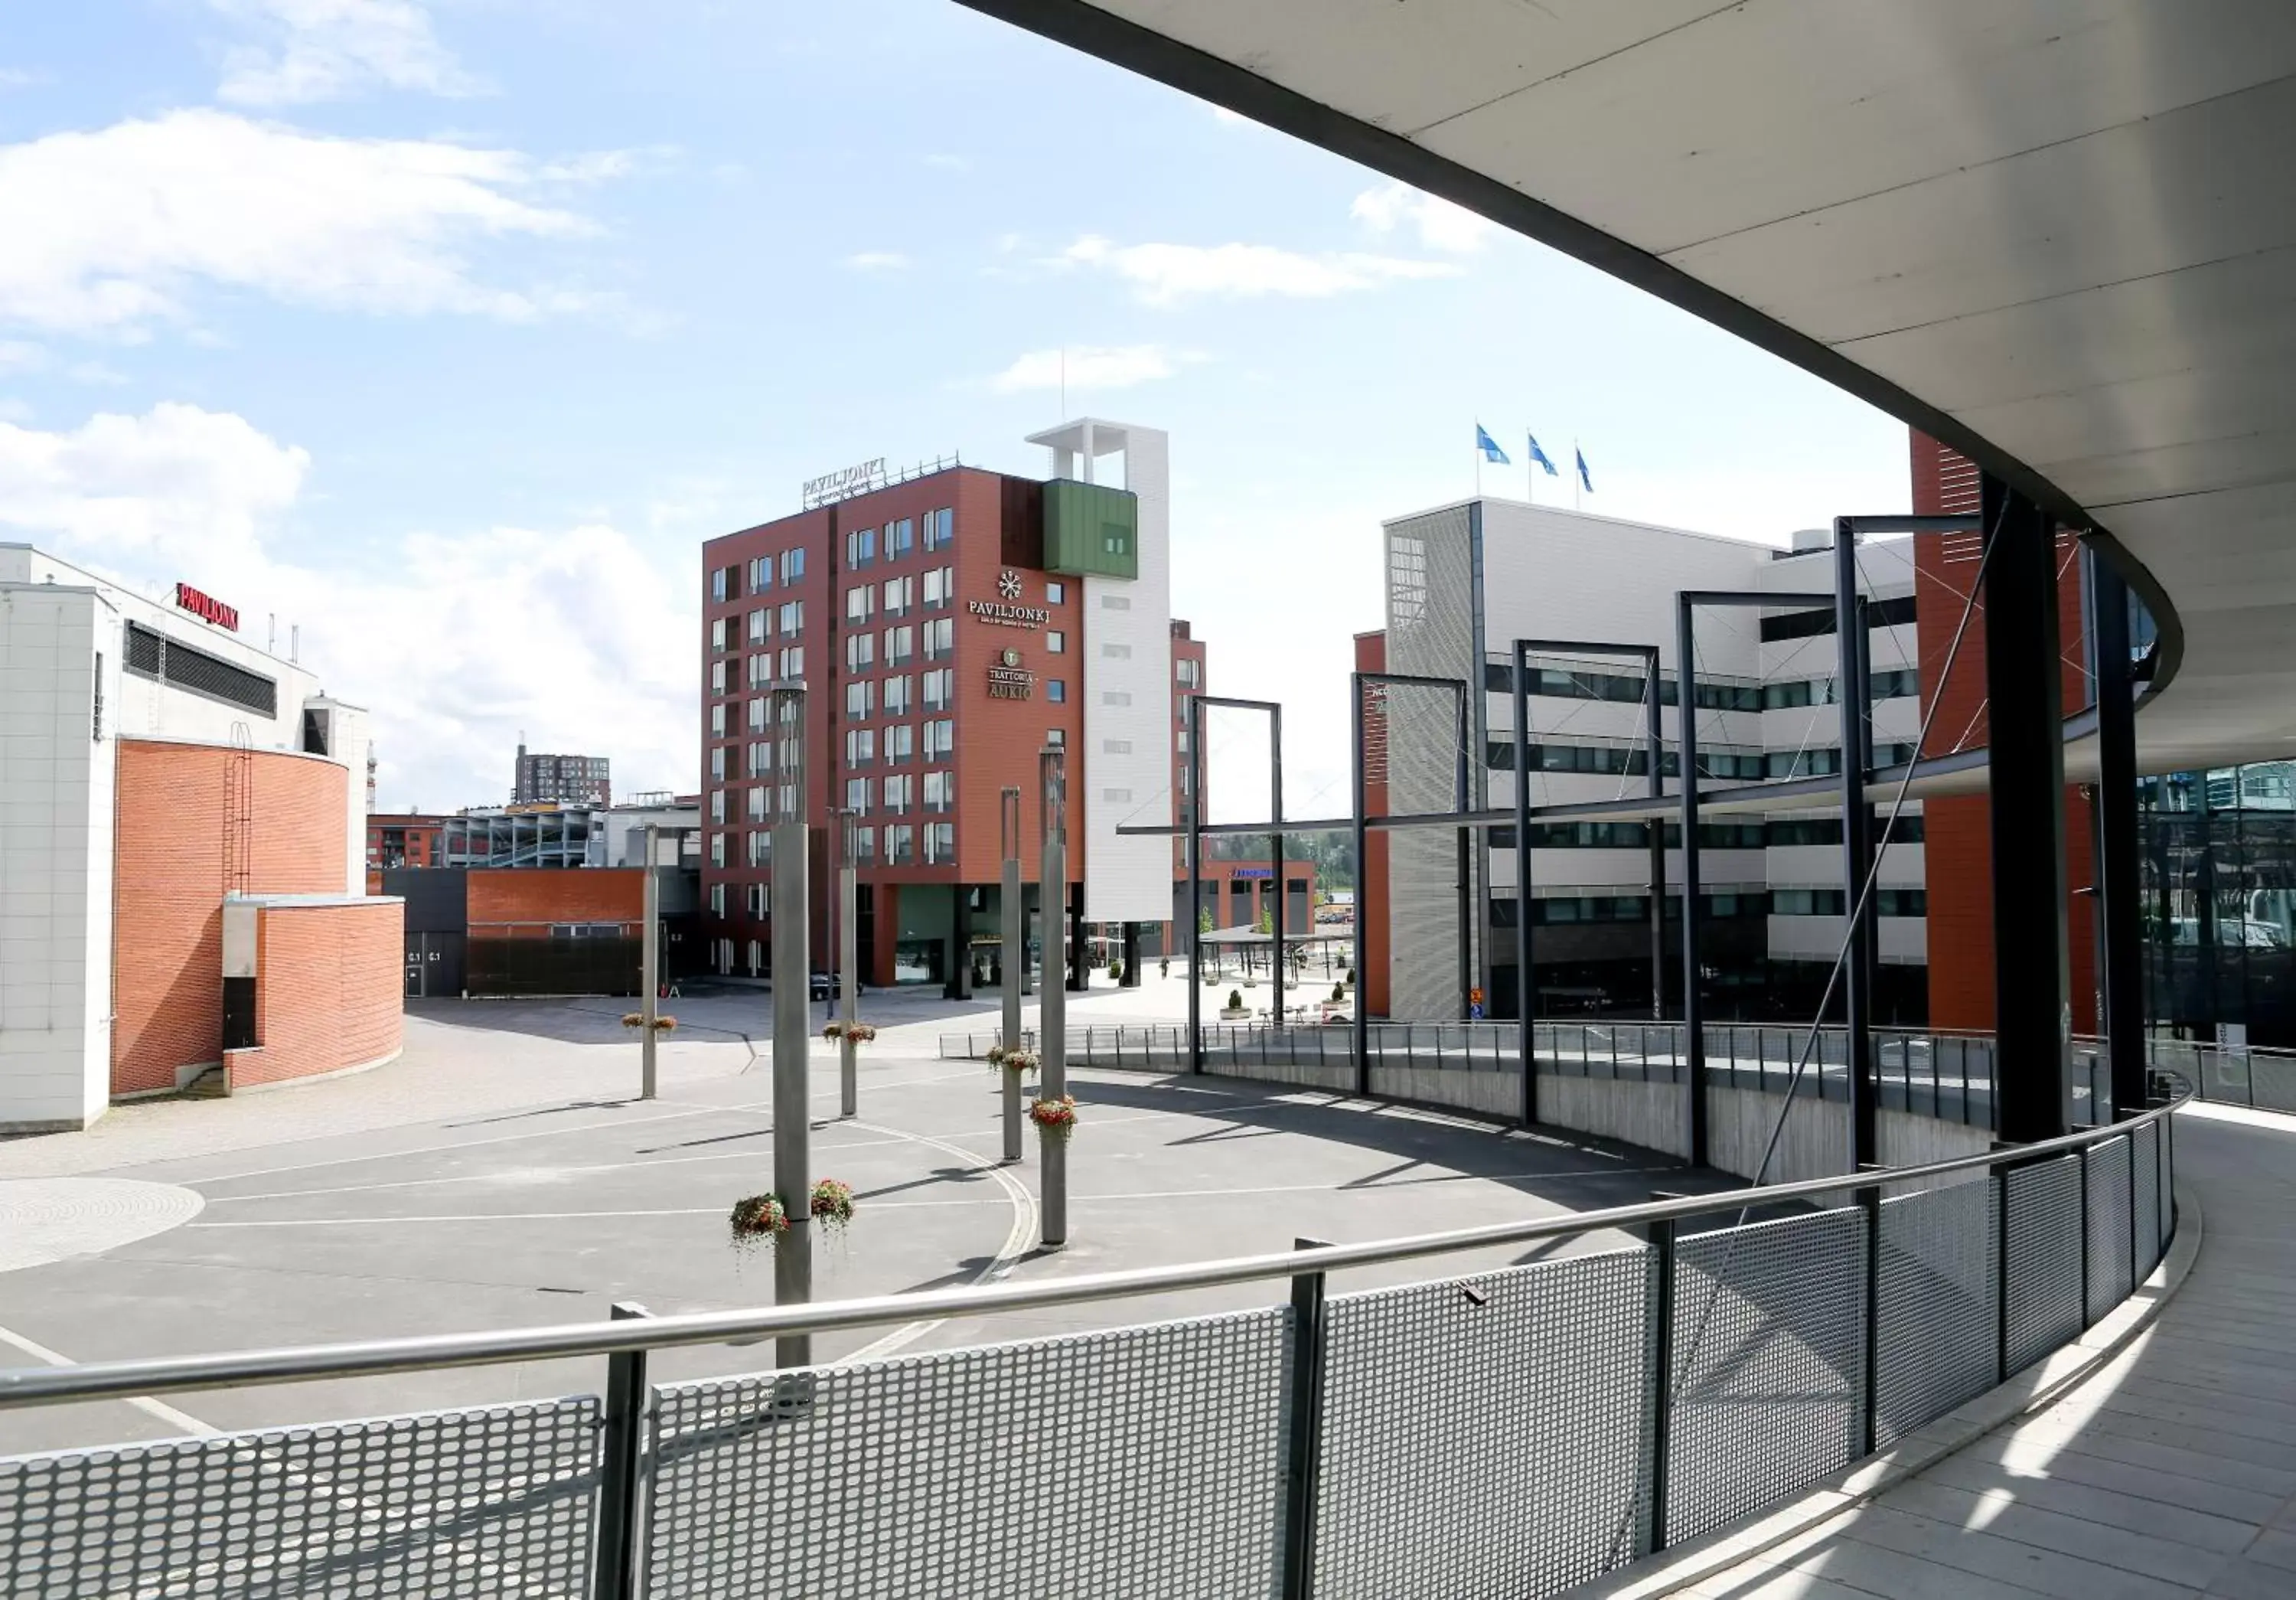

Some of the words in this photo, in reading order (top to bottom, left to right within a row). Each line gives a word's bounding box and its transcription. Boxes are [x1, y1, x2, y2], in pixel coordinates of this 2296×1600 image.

[969, 600, 1051, 623] PAVILJONKI
[990, 670, 1032, 682] TRATTORIA
[990, 684, 1032, 700] AUKIO
